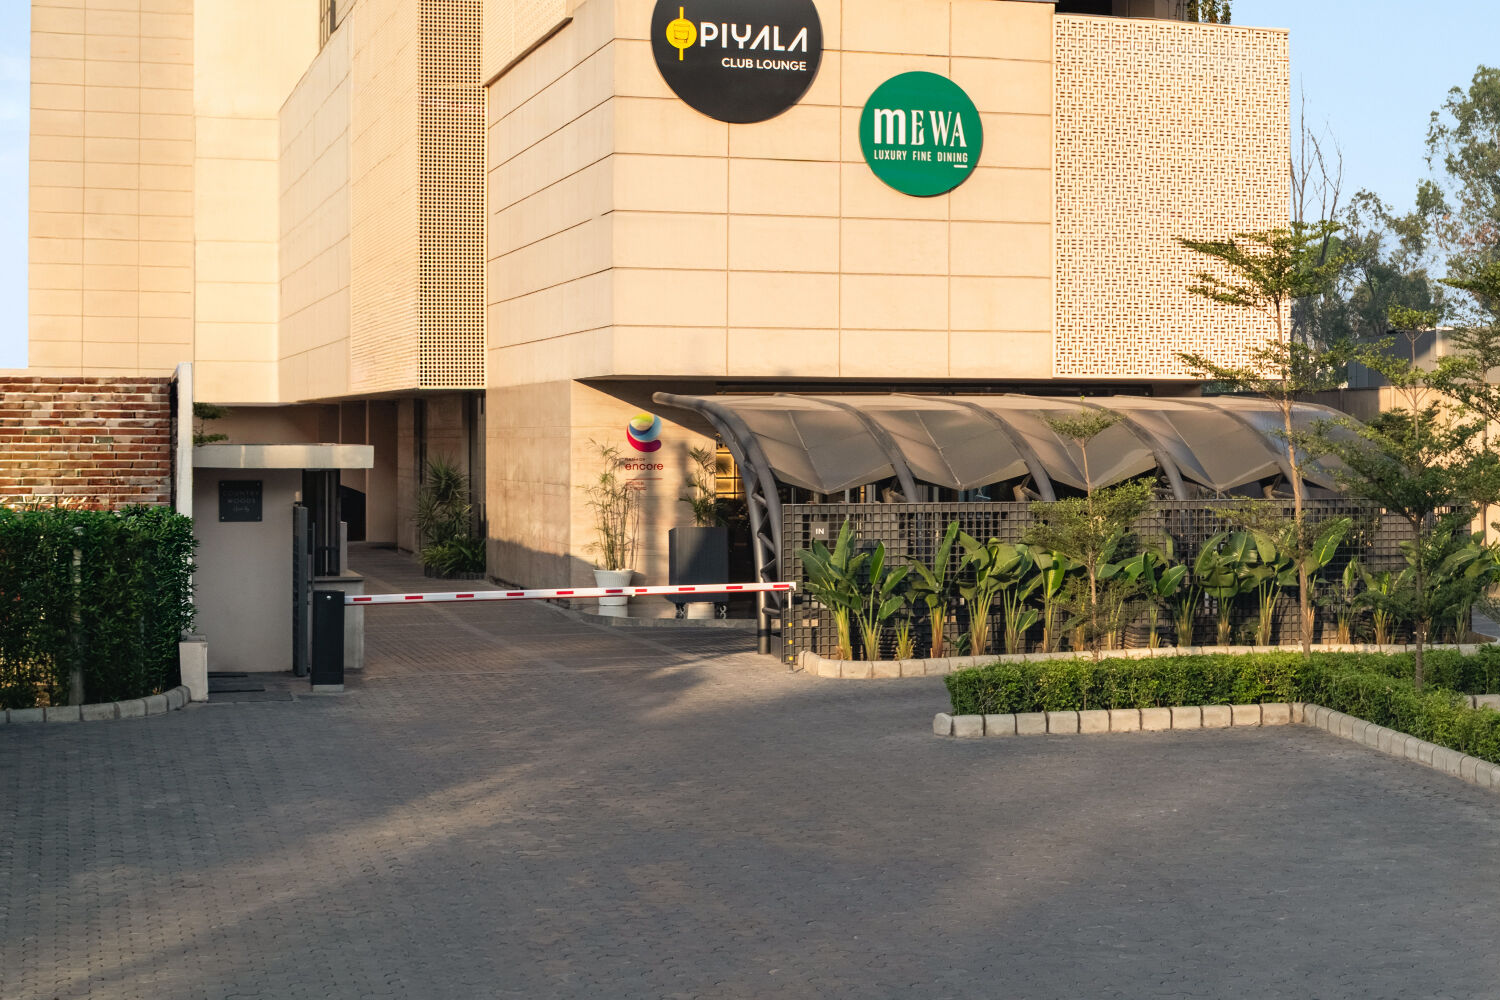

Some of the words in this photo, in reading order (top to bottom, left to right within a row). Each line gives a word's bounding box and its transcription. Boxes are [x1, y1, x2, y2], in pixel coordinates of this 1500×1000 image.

[700, 21, 808, 53] PIYALA
[721, 57, 754, 69] CLUB
[756, 58, 807, 71] LOUNGE
[874, 149, 907, 161] LUXURY
[912, 150, 932, 162] FINE
[937, 151, 969, 163] DINING
[815, 527, 825, 535] IN
